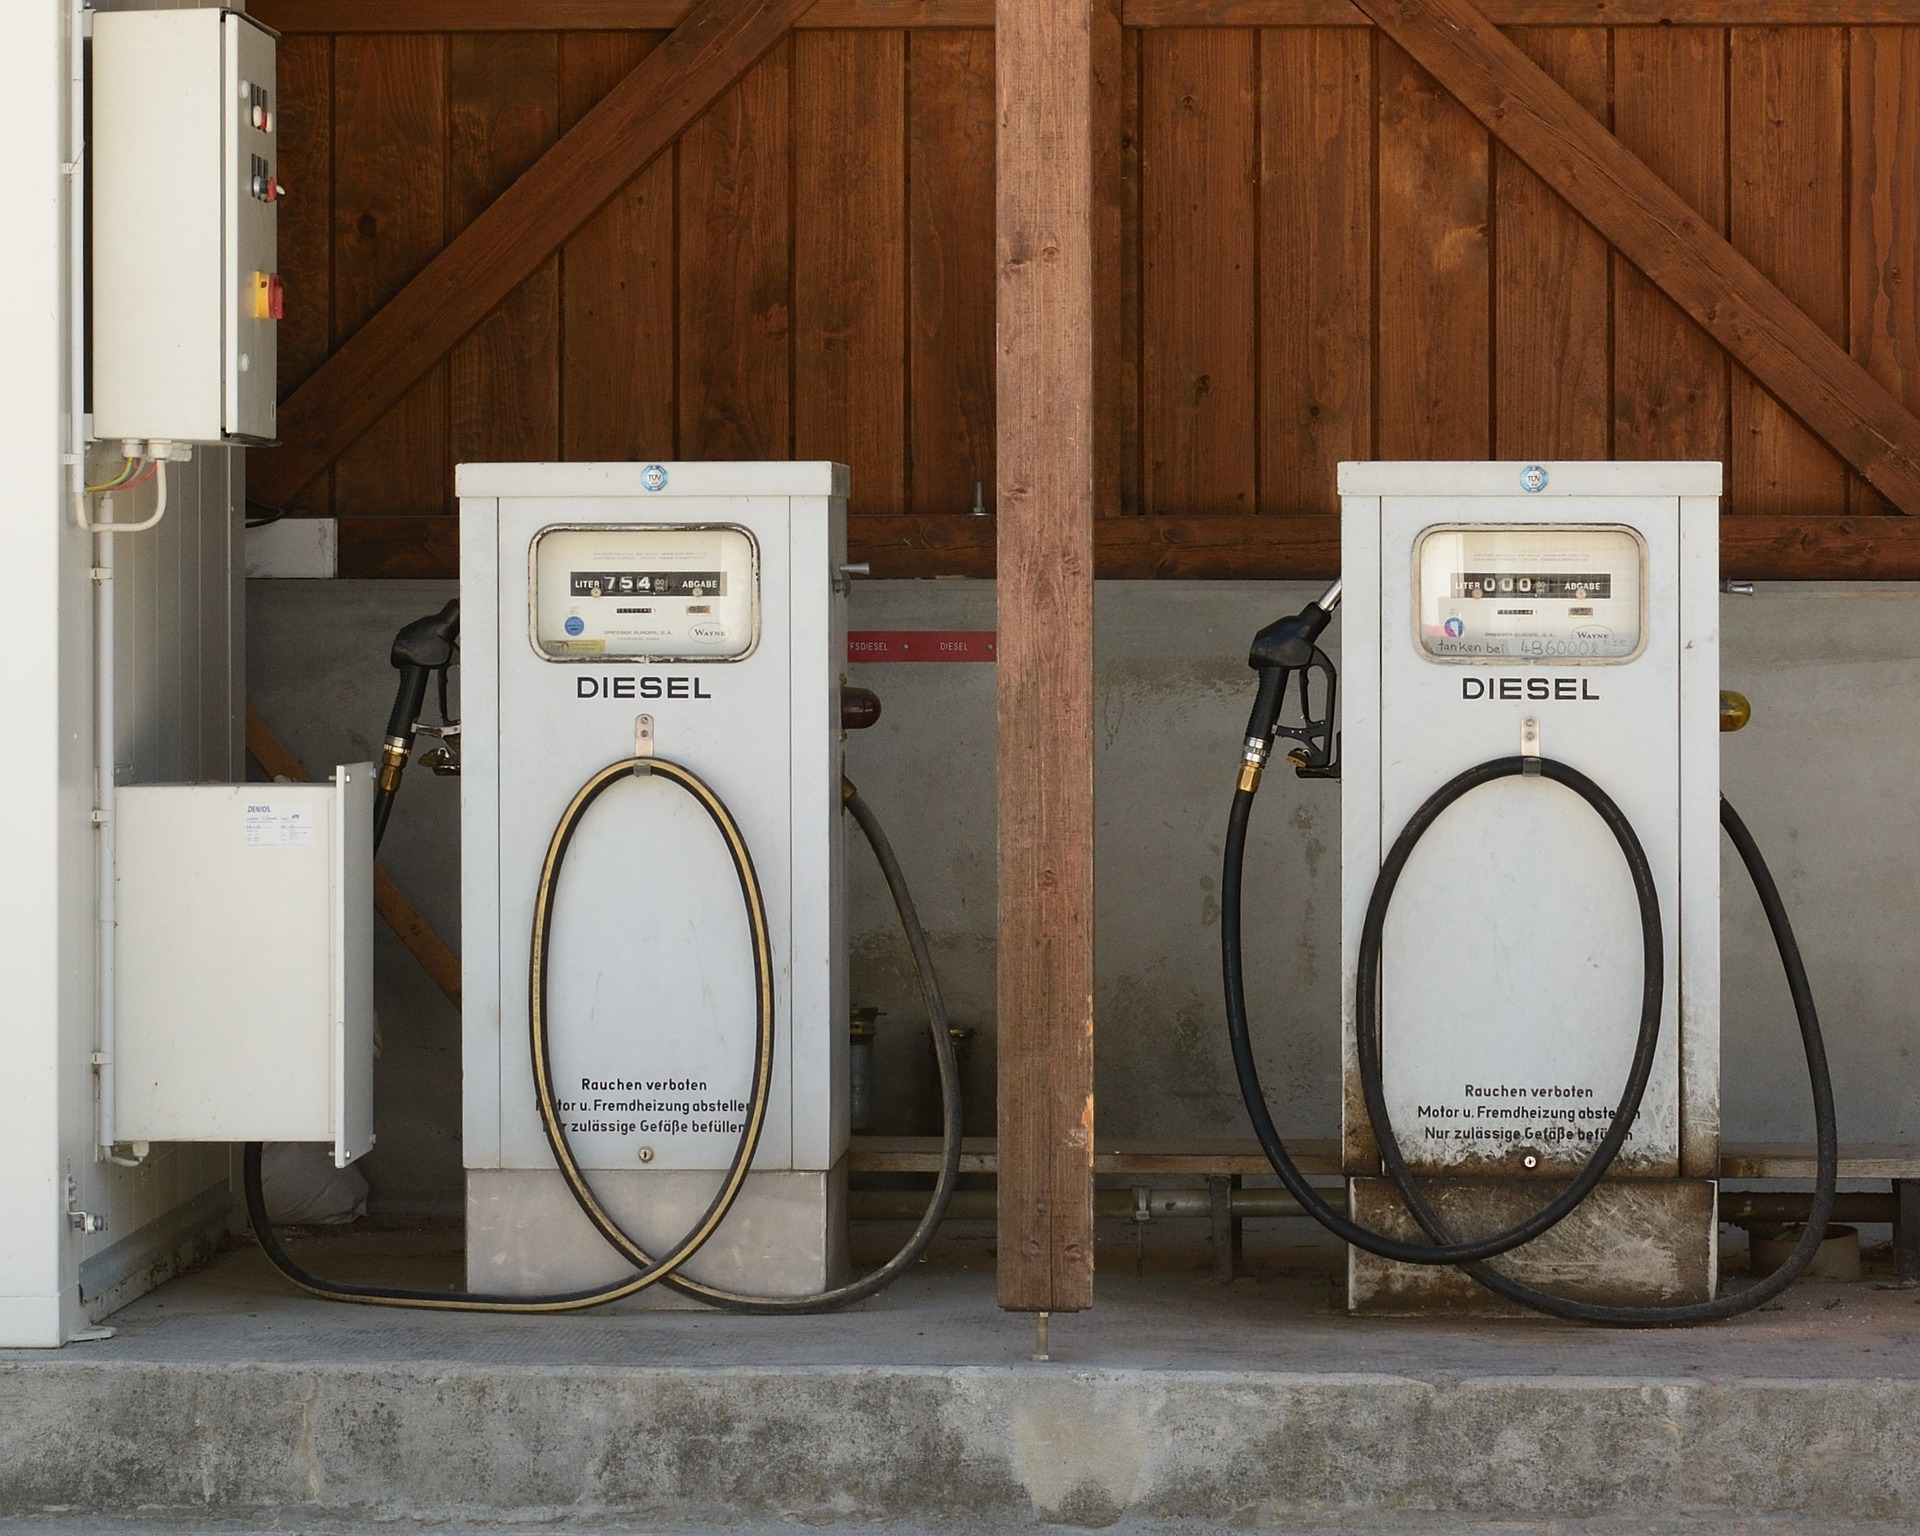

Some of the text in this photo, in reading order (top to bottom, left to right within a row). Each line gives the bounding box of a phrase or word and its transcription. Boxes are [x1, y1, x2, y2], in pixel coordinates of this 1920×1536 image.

[575, 580, 600, 588] LITER
[603, 576, 651, 590] 754
[681, 580, 717, 588] ABGABE
[1455, 581, 1481, 589] LITER
[1483, 577, 1532, 592] 000
[1564, 582, 1601, 590] ABGABE
[848, 642, 887, 651] FSDIESEL
[940, 642, 968, 651] DIESEL
[1438, 639, 1482, 652] tanken
[1486, 642, 1505, 654] bei
[577, 677, 711, 698] DIESEL
[1462, 678, 1600, 700] DIESEL
[581, 1078, 707, 1091] Rauchen verboten
[1465, 1084, 1593, 1098] Rauchen verboten
[579, 1101, 591, 1111] u.
[593, 1099, 690, 1115] Fremdheizung
[1417, 1106, 1459, 1118] Motor
[1463, 1108, 1474, 1118] u.
[1477, 1106, 1575, 1122] Fremdheizung
[571, 1119, 636, 1136] zulässige
[640, 1119, 688, 1136] Gefäße
[1425, 1127, 1450, 1139] Nur
[1454, 1127, 1521, 1143] zulässige
[1524, 1127, 1574, 1143] Gefäße
